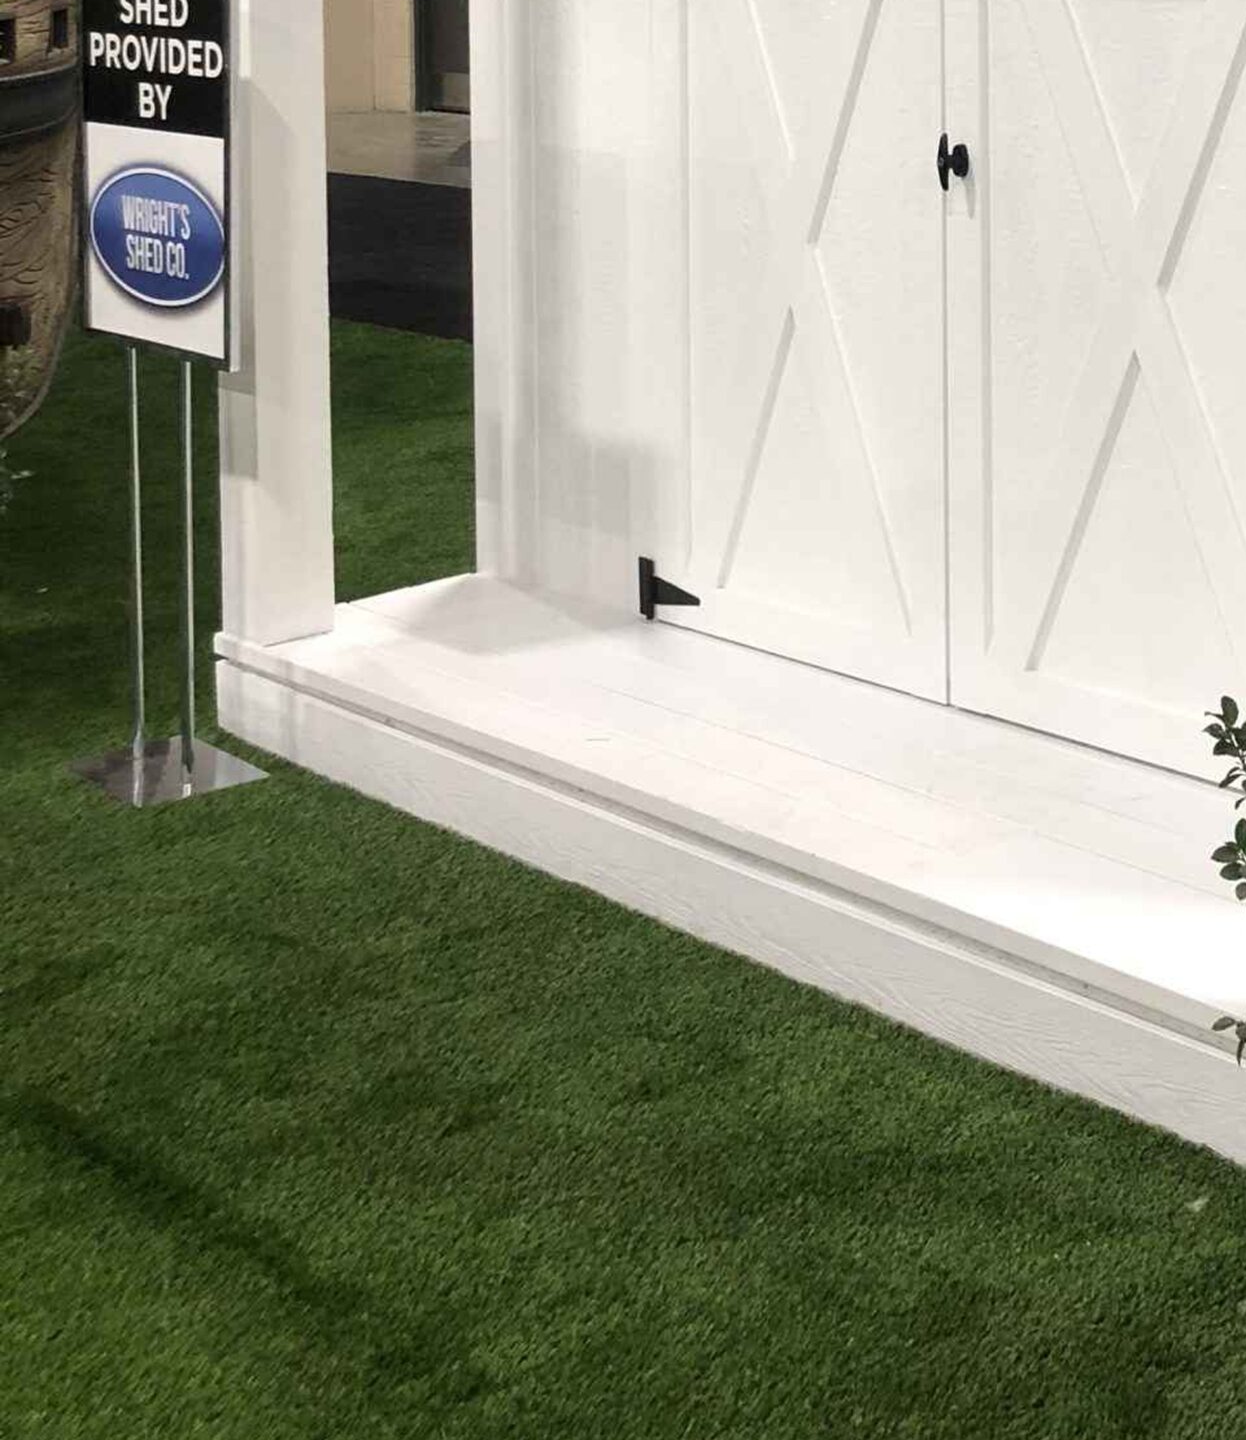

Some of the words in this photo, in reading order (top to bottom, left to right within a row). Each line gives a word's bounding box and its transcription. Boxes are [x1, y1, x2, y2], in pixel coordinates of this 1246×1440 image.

[89, 31, 223, 78] PROVIDED
[138, 82, 172, 120] BY
[121, 195, 191, 240] WRIGHT'S
[126, 234, 163, 274] SHED
[166, 241, 190, 280] CO.
